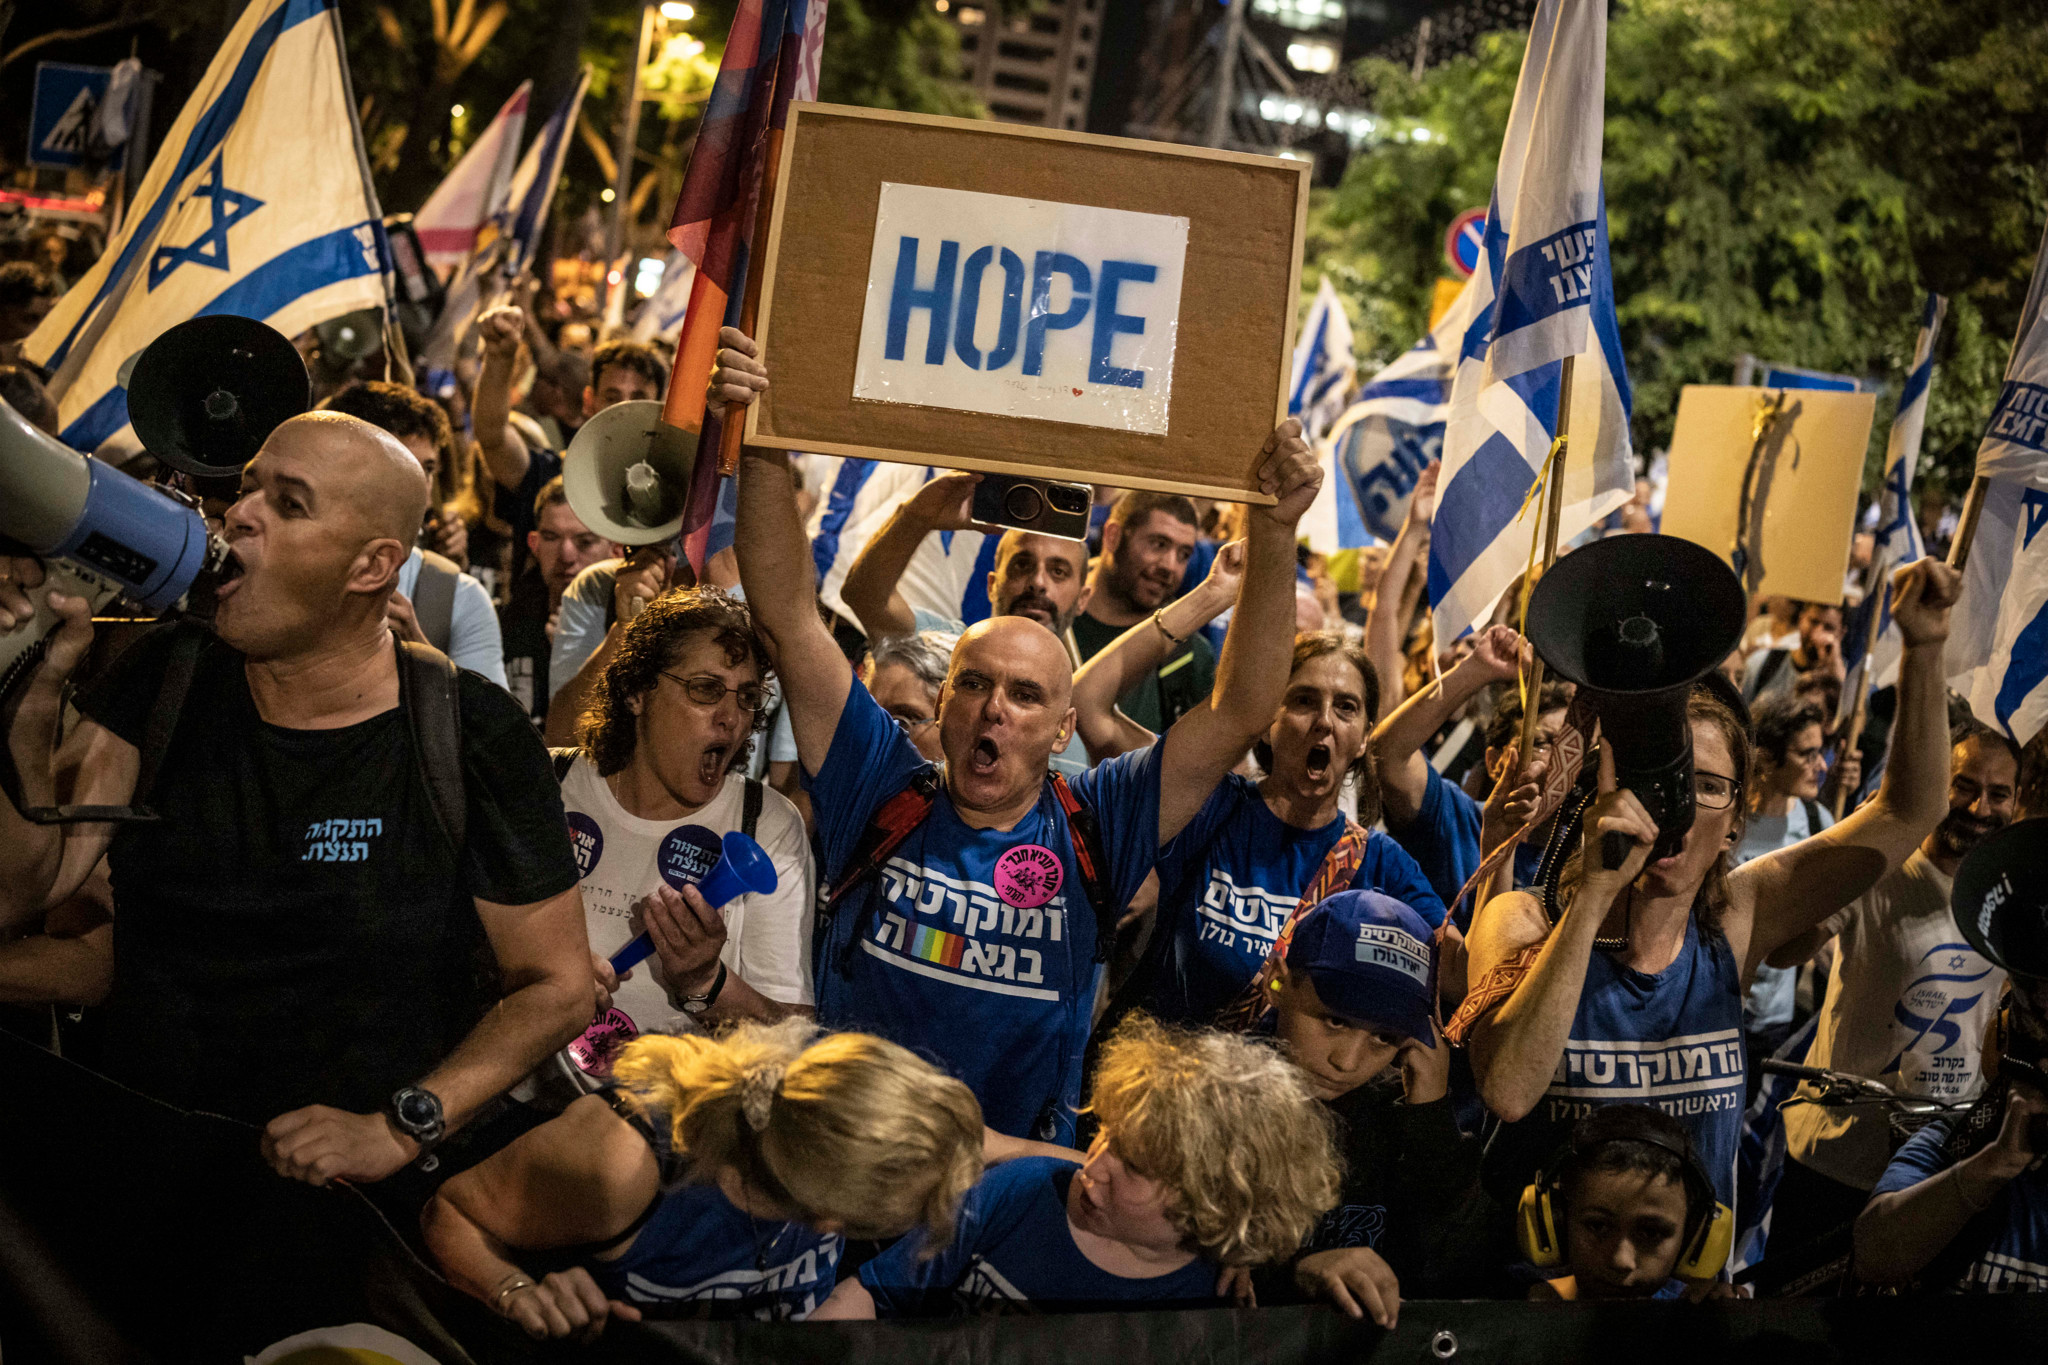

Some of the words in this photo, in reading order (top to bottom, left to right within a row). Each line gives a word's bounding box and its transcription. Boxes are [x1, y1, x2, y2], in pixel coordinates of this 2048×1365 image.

[884, 235, 1157, 389] HOPE
[1199, 921, 1236, 948] גולן
[1243, 937, 1274, 958] איר
[1359, 928, 1431, 962] הדמוקרטים
[1373, 947, 1398, 966] גולן
[1400, 956, 1421, 974] יאיר
[1909, 994, 1944, 1009] ישראל
[1916, 989, 1947, 1000] ISRAEL
[1932, 1056, 1965, 1071] בקרוב
